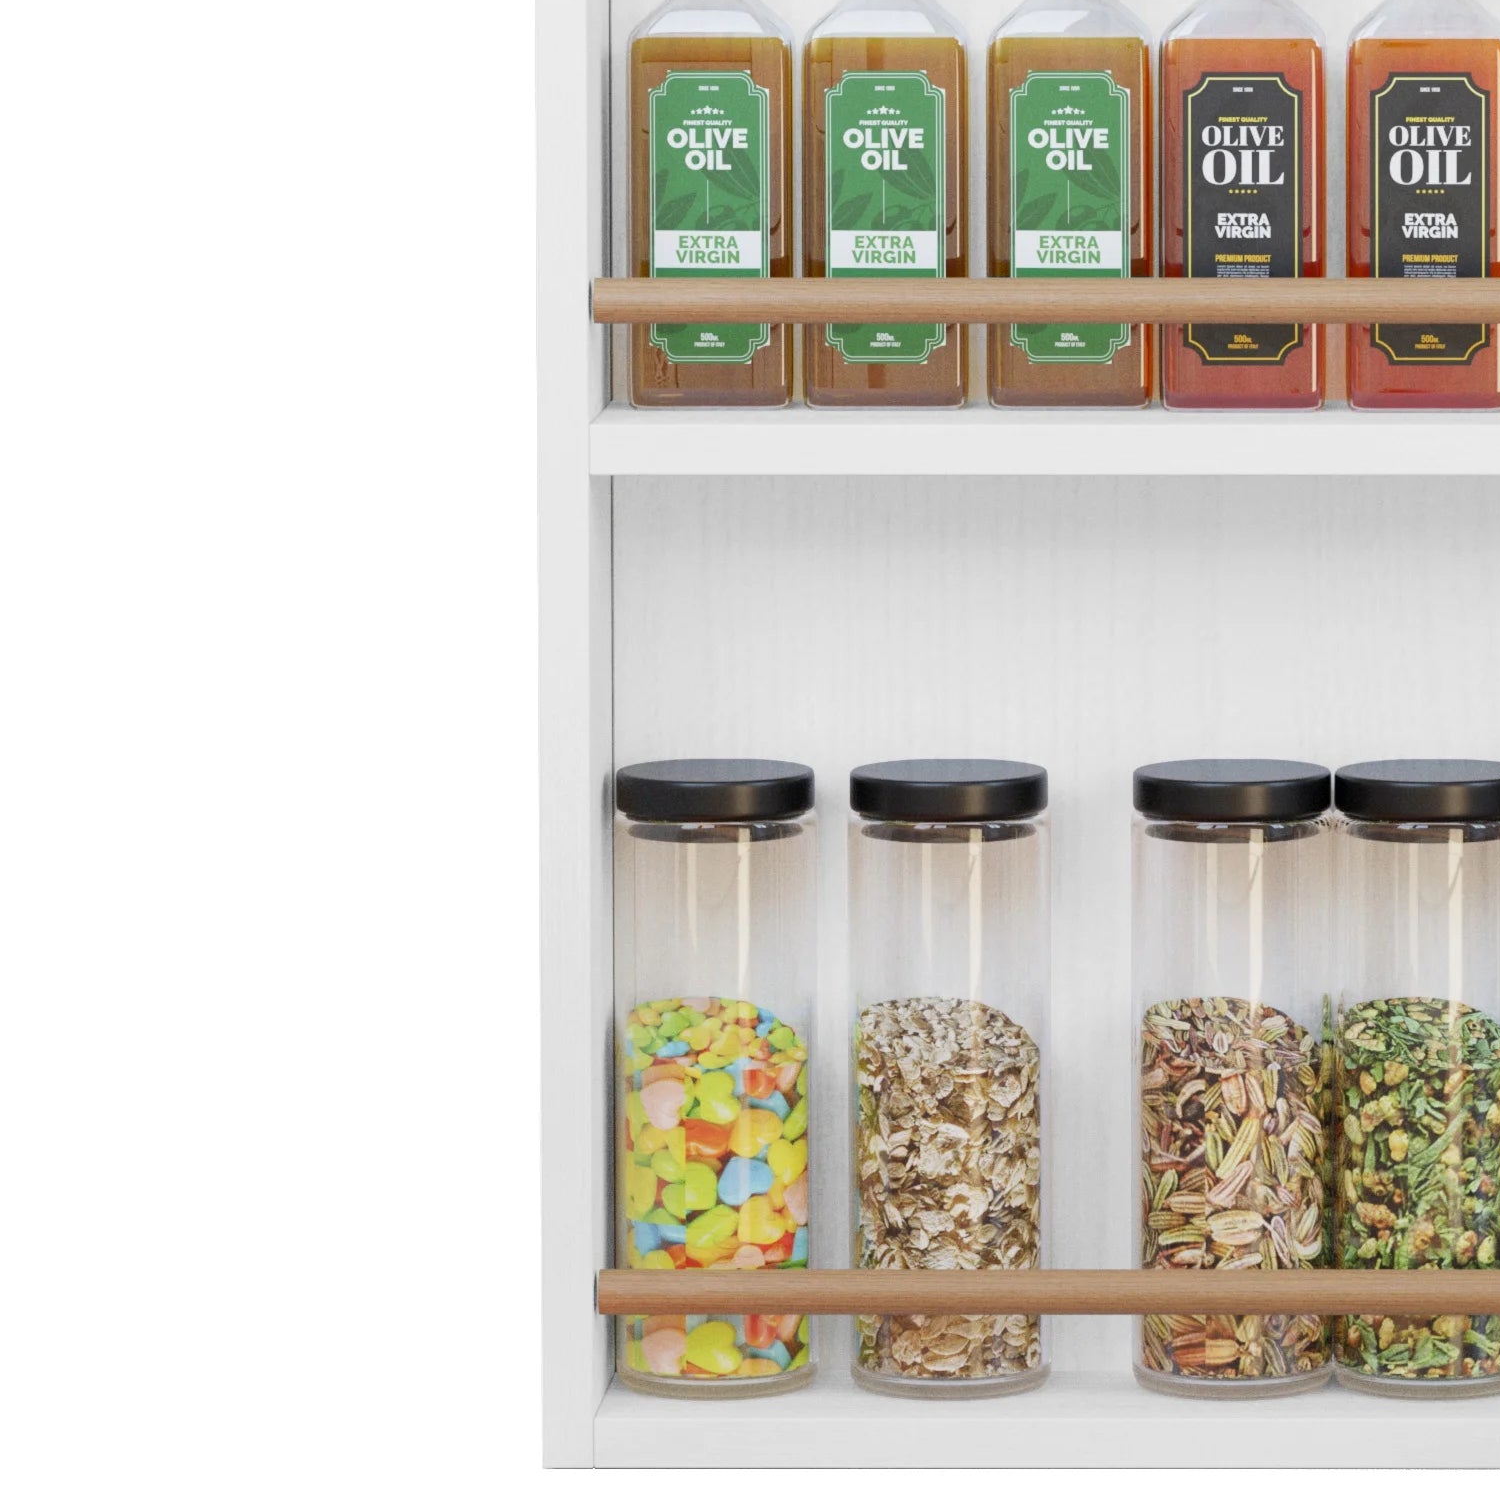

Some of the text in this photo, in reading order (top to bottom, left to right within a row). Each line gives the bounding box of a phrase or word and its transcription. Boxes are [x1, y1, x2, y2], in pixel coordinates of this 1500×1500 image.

[667, 128, 748, 149] OLIVE
[843, 128, 924, 149] OLIVE
[1028, 128, 1109, 149] OLIVE
[1202, 125, 1284, 147] OLIVE
[1388, 125, 1472, 147] OLIVE
[684, 150, 732, 171] OIL
[860, 150, 908, 171] OIL
[1046, 150, 1092, 171] OIL
[1202, 149, 1284, 185] OIL
[1388, 149, 1472, 185] OIL
[1218, 213, 1269, 226] EXTRA
[1404, 213, 1456, 226] EXTRA
[1214, 226, 1272, 239] VIRGIN
[1402, 226, 1458, 239] VIRGIN
[678, 235, 738, 249] EXTRA
[854, 235, 914, 249] EXTRA
[1040, 235, 1099, 249] EXTRA
[676, 250, 740, 264] VIRGIN
[852, 250, 916, 264] VIRGIN
[1037, 250, 1101, 264] VIRGIN
[1215, 254, 1272, 263] PREMIUM PRODUCT
[1402, 254, 1459, 263] PREMIUM PRODUCT
